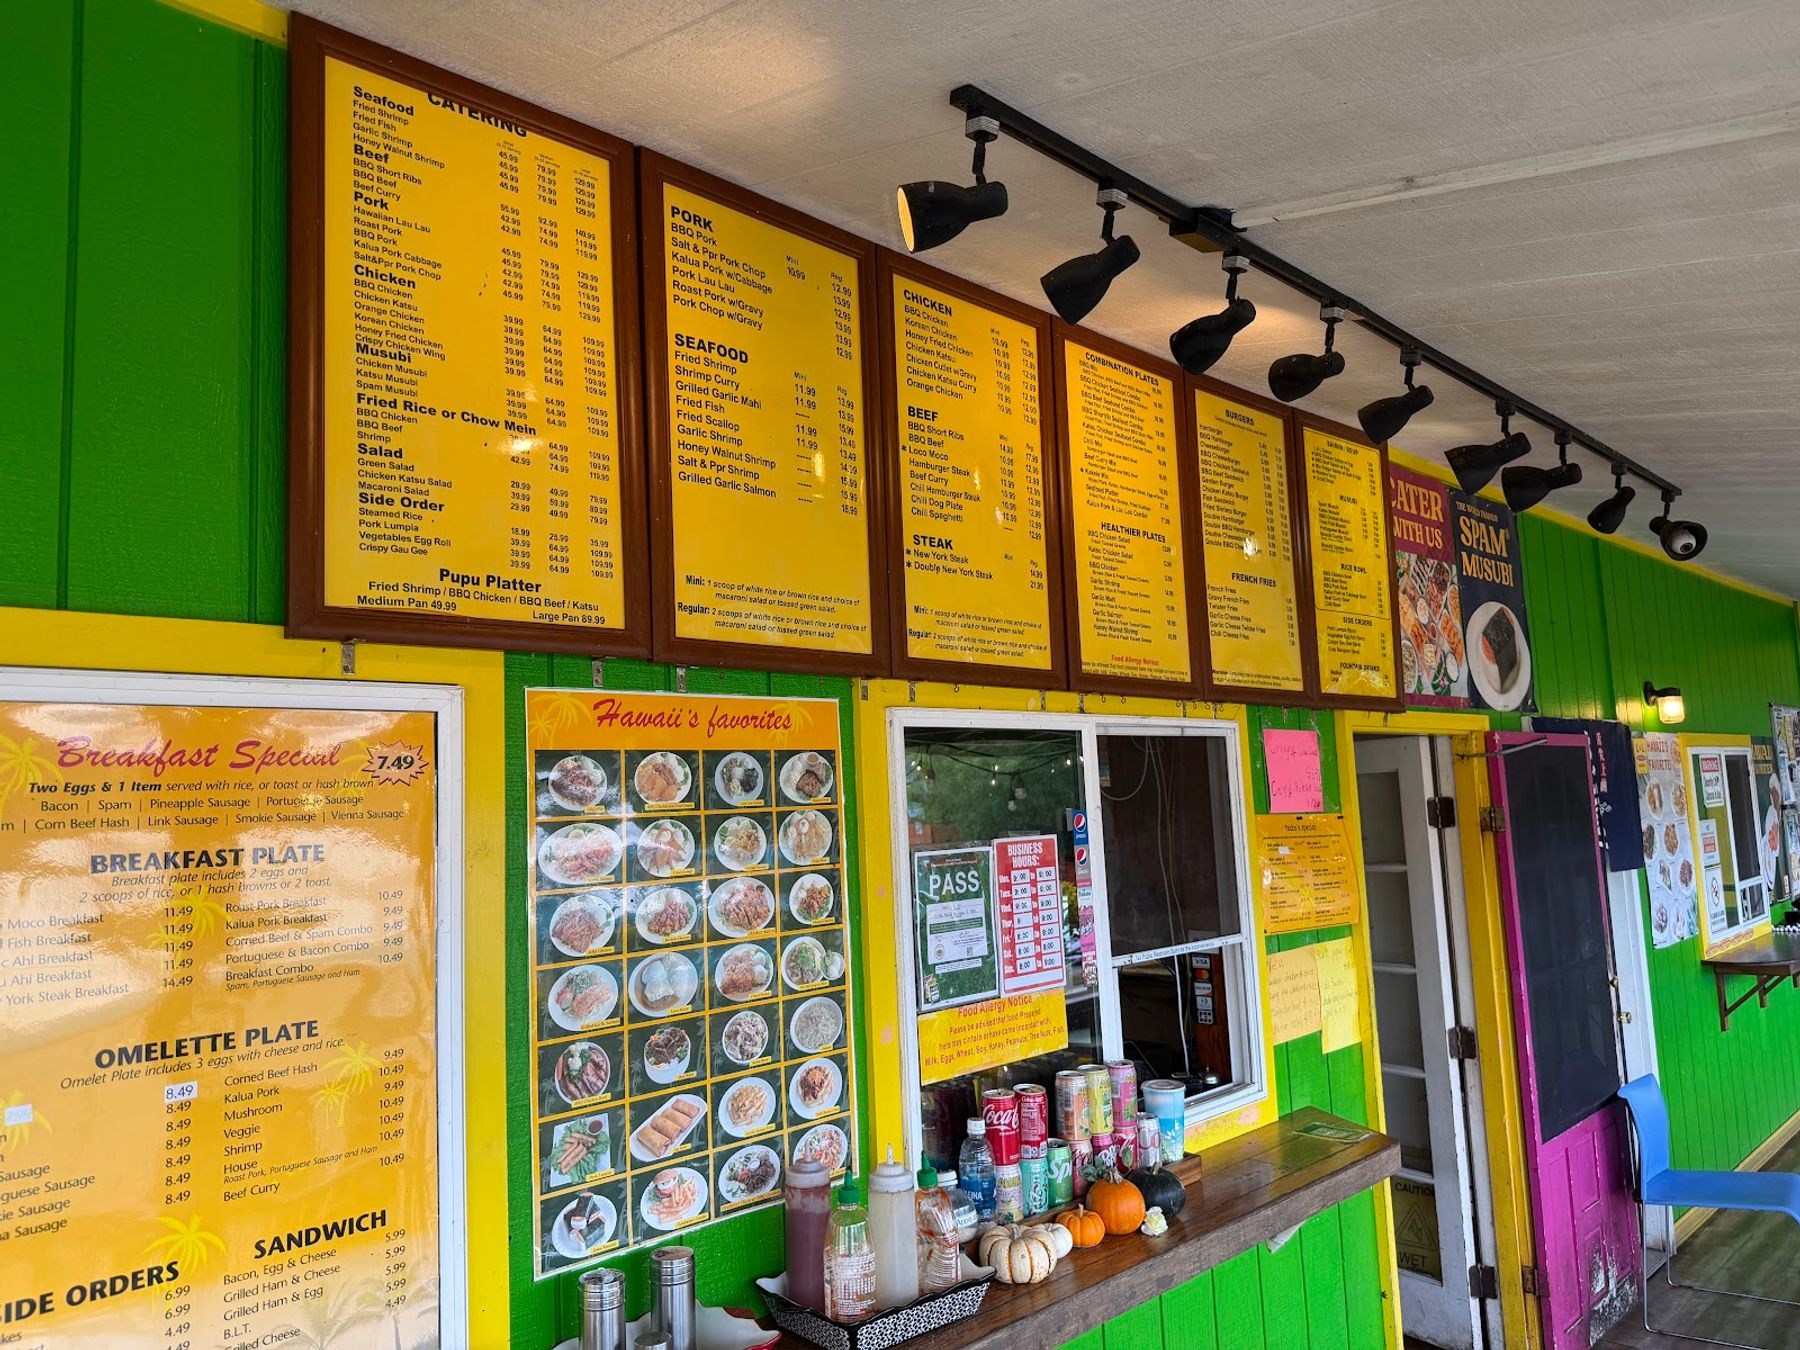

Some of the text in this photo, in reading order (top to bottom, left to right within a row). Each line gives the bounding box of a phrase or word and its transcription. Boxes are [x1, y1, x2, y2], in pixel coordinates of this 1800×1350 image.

[354, 86, 414, 116] Seafood
[353, 100, 409, 126] Fried Shrimp
[353, 123, 413, 148] Garlic Shrimp
[353, 134, 445, 169] Honey Walnut Shrimp
[354, 144, 389, 163] Beef
[353, 158, 422, 185] BBQ Short Ribs
[354, 192, 388, 210] Pork
[354, 205, 431, 233] Hawaiian Lau Lau
[671, 205, 713, 232] PORK
[671, 222, 717, 246] BBQ Pork
[354, 239, 442, 270] Kalua Pork Cabbage
[354, 265, 416, 289] Chicken
[672, 266, 735, 293] Pork Lau Lau
[672, 280, 700, 297] Roast
[702, 288, 726, 304] Pork
[904, 289, 952, 316] CHICKEN
[356, 343, 411, 363] Musubi
[675, 333, 748, 364] SEAFOOD
[675, 351, 737, 375] Fried Shrimp
[1086, 353, 1159, 386] COMBINATION PLATES
[675, 365, 740, 390] Shrimp Curry
[357, 393, 536, 436] Fried Rice or Chow Mein
[677, 409, 740, 433] Fried Scallop
[908, 406, 938, 422] BEEF
[1225, 410, 1254, 426] BURGERS
[677, 424, 743, 447] Garlic Shrimp
[358, 443, 403, 459] Salad
[678, 439, 776, 470] Honey Walnut Shrimp
[678, 471, 776, 498] Grilled Garlic Salmon
[359, 493, 444, 512] Side Order
[359, 506, 423, 521] Steamed Rice
[359, 530, 451, 546] Vegetables Egg Roll
[913, 535, 953, 550] STEAK
[1101, 521, 1166, 544] HEALTHIER PLATES
[1425, 526, 1443, 549] US
[1460, 516, 1508, 558] SPAM
[359, 542, 388, 554] Crispy
[391, 544, 409, 555] Gau
[913, 548, 968, 564] New York Steak
[440, 568, 541, 593] Pupu Platter
[686, 574, 705, 588] Mini:
[1232, 573, 1276, 587] FRENCH FRIES
[1461, 552, 1514, 587] MUSUBI
[357, 595, 456, 610] Medium Pan 49.99
[369, 580, 599, 611] Fried Shrimp BBQ Chicken BBQ Beef Katsu
[533, 610, 605, 624] Large Pan 89.99
[678, 602, 710, 616] Regular:
[593, 698, 792, 738] Hawaii's favorites
[57, 735, 219, 778] Breakfast
[377, 756, 414, 770] 7.49
[29, 777, 374, 795] Two Eggs & 1 Item served with rice, or toast or hash brown
[41, 800, 78, 812] Bacon
[98, 799, 132, 813] Spam
[150, 797, 250, 812] Pineapple Sausage
[91, 844, 325, 874] BREAKFAST PLATE
[1008, 842, 1043, 856] BUSINESS
[1013, 855, 1040, 868] HOURS:
[929, 870, 980, 897] PASS
[1008, 995, 1032, 1006] Notice
[95, 1020, 319, 1069] OMELETTE PLATE
[224, 1062, 317, 1086] Corned Beef Hash
[224, 1086, 280, 1104] Kalua Pork
[224, 1102, 283, 1123] Mushroom
[224, 1123, 260, 1140] Veggie
[224, 1141, 263, 1158] Shrimp
[223, 1180, 280, 1202] Beef Curry
[1395, 1182, 1434, 1196] CAUTIO
[254, 1209, 387, 1259] SANDWICH
[0, 1261, 179, 1325] IDE ORDERS
